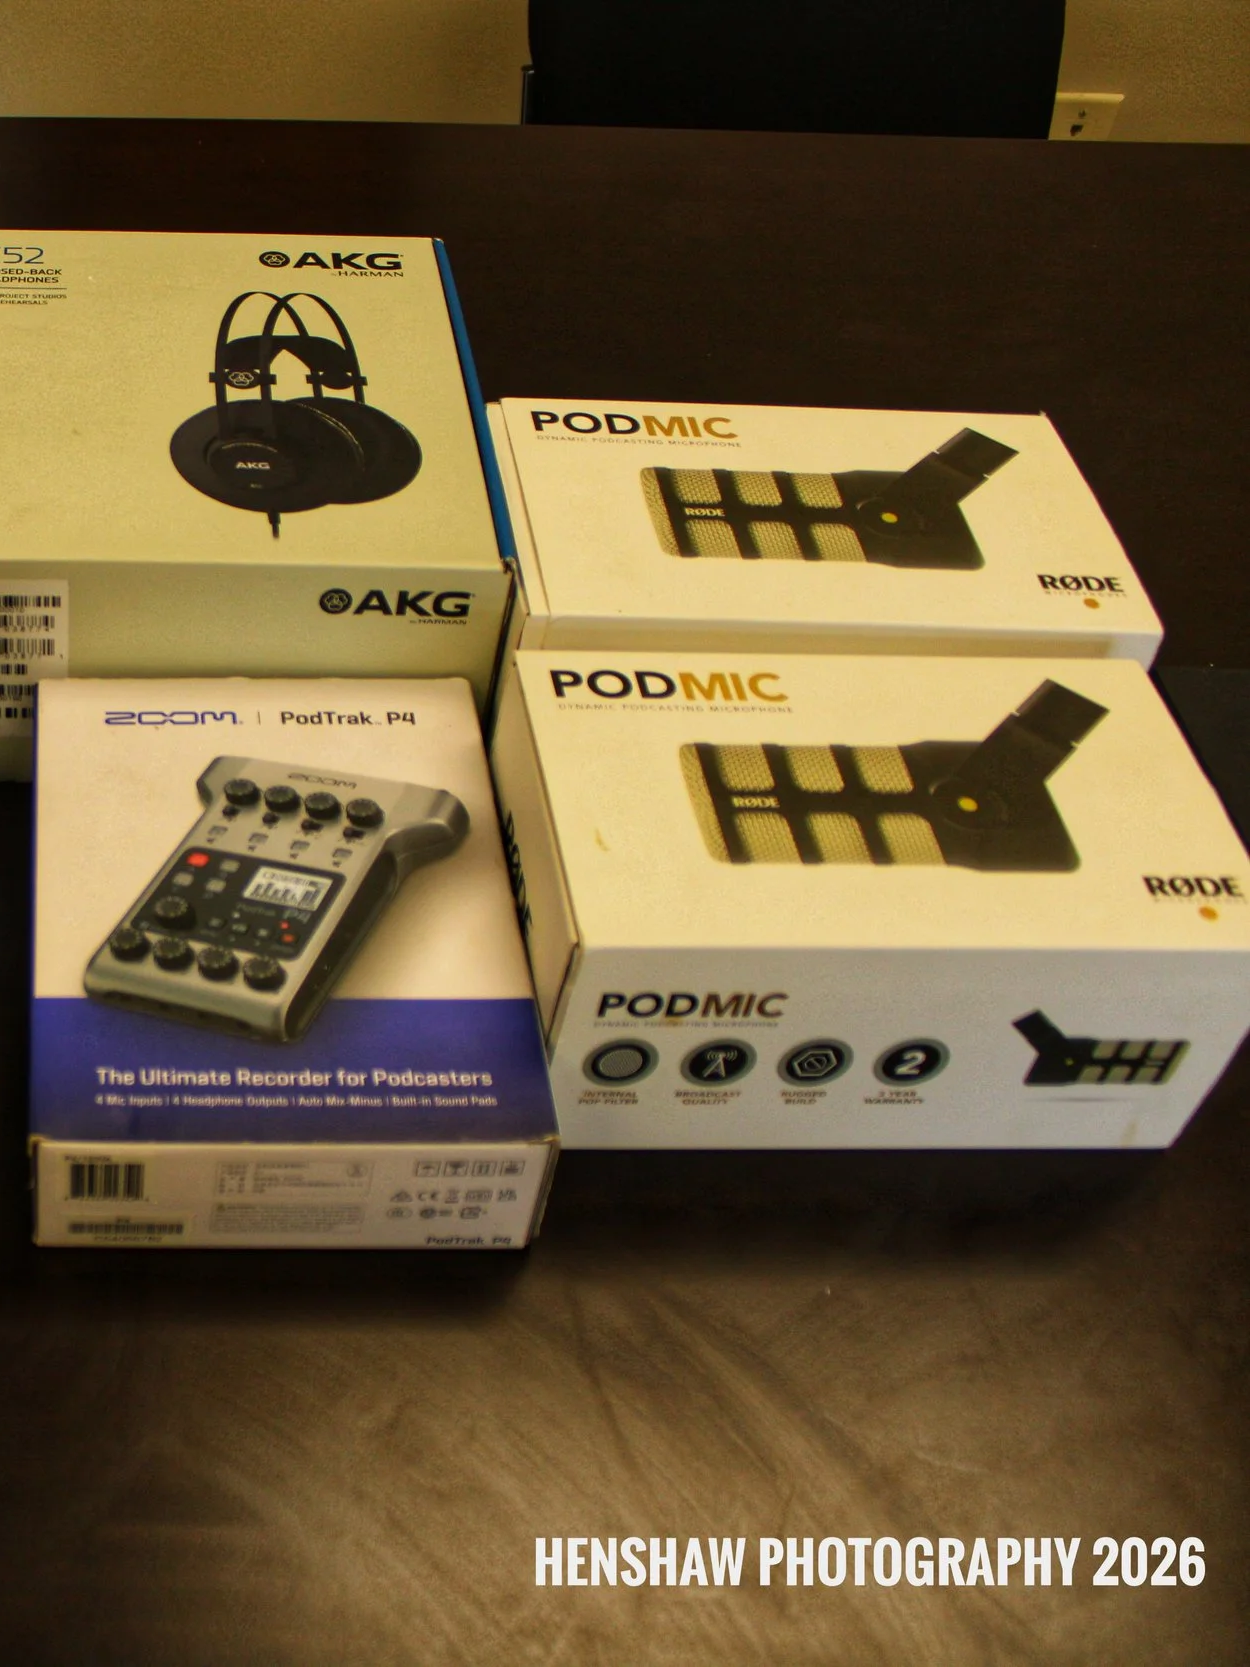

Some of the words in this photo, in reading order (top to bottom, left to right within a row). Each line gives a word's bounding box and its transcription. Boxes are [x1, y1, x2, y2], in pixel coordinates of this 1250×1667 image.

[293, 252, 402, 270] AKG
[530, 411, 738, 439] PODMIC
[536, 434, 586, 443] DYNAMIC
[592, 437, 664, 445] PODCASTING
[668, 440, 741, 448] MICROPHONE
[236, 461, 270, 469] AKG
[1036, 574, 1124, 592] RØDE
[353, 589, 472, 617] AKG
[550, 669, 789, 701] PODMIC
[104, 711, 238, 725] ZOOM
[281, 710, 373, 725] PodTrak
[387, 711, 416, 725] P4
[1141, 875, 1244, 897] RØDE
[597, 992, 789, 1018] PODMIC
[896, 1050, 926, 1076] 2
[96, 1067, 135, 1086] The
[139, 1067, 231, 1086] Ultimate
[236, 1067, 332, 1087] Recorder
[337, 1067, 368, 1087] for
[373, 1067, 493, 1087] Podcasters
[674, 1090, 742, 1098] BROADCAST
